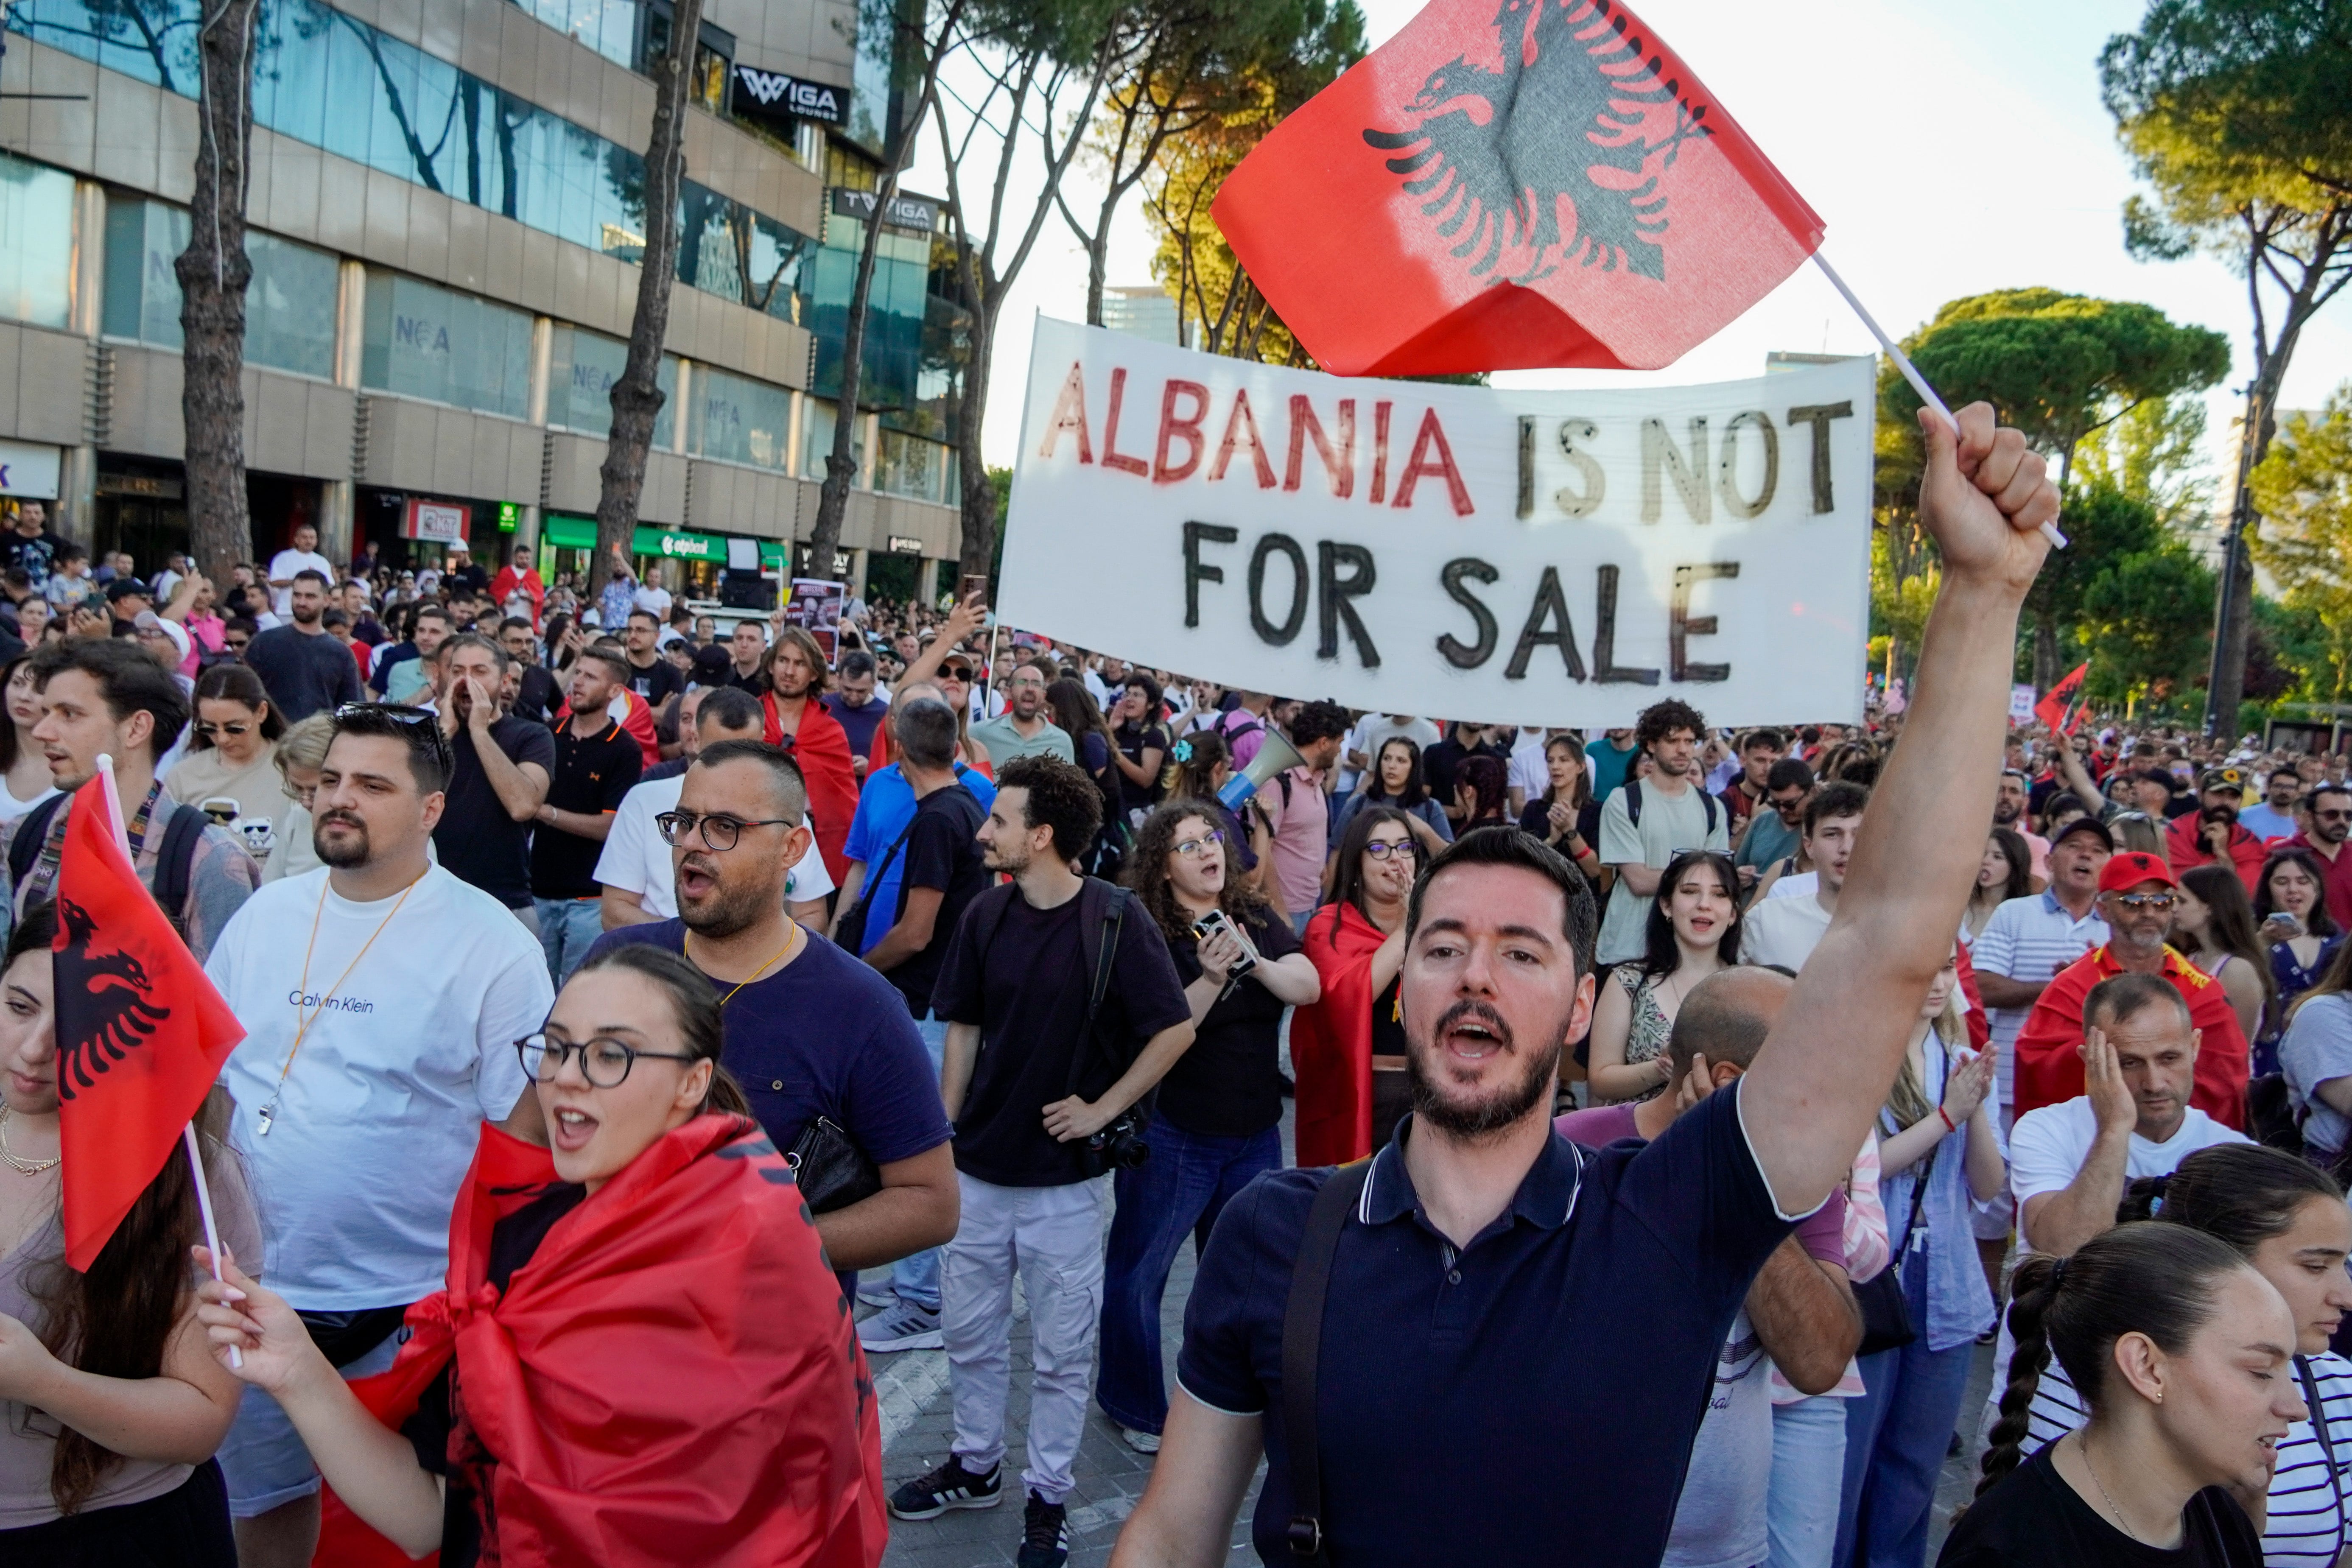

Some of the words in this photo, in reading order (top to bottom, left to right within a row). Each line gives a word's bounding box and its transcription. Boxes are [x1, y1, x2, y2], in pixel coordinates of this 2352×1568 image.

[733, 67, 838, 112] WIGA
[1039, 360, 1475, 516] ALBANIA
[1516, 414, 1606, 520] IS
[1640, 400, 1854, 525] NOT
[1182, 520, 1382, 669] FOR
[1436, 557, 1740, 685] SALE
[289, 991, 339, 1010] Calvin
[341, 997, 373, 1014] Klein
